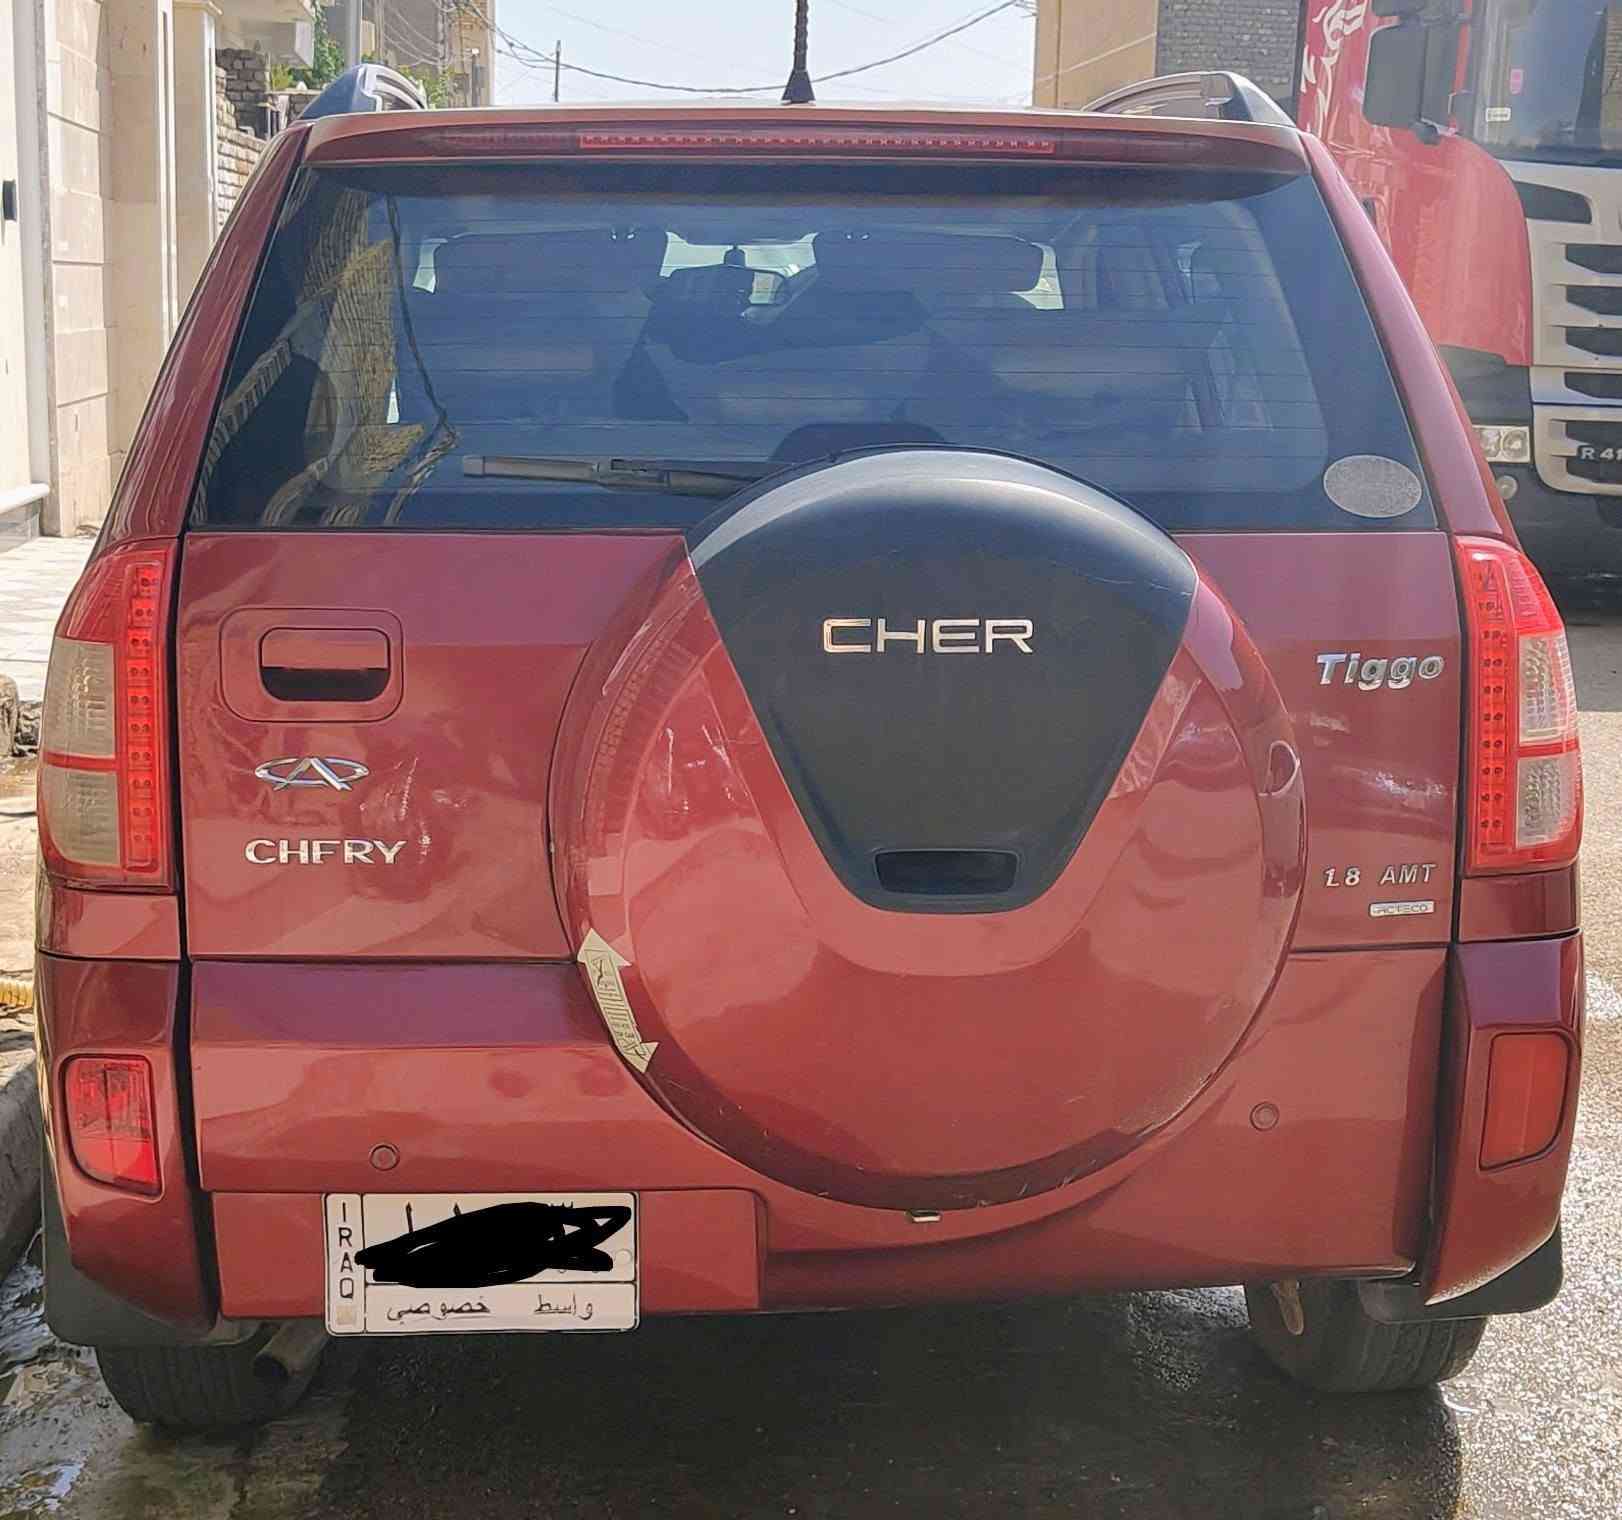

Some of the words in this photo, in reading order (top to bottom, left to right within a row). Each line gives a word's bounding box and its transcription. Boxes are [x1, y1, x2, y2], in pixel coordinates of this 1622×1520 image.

[1580, 447, 1595, 460] R
[822, 617, 1034, 654] CHER
[1316, 652, 1445, 691] Tiggo
[1379, 863, 1437, 886] AMT
[338, 1201, 354, 1299] IRAQ
[533, 1293, 594, 1321] واسط
